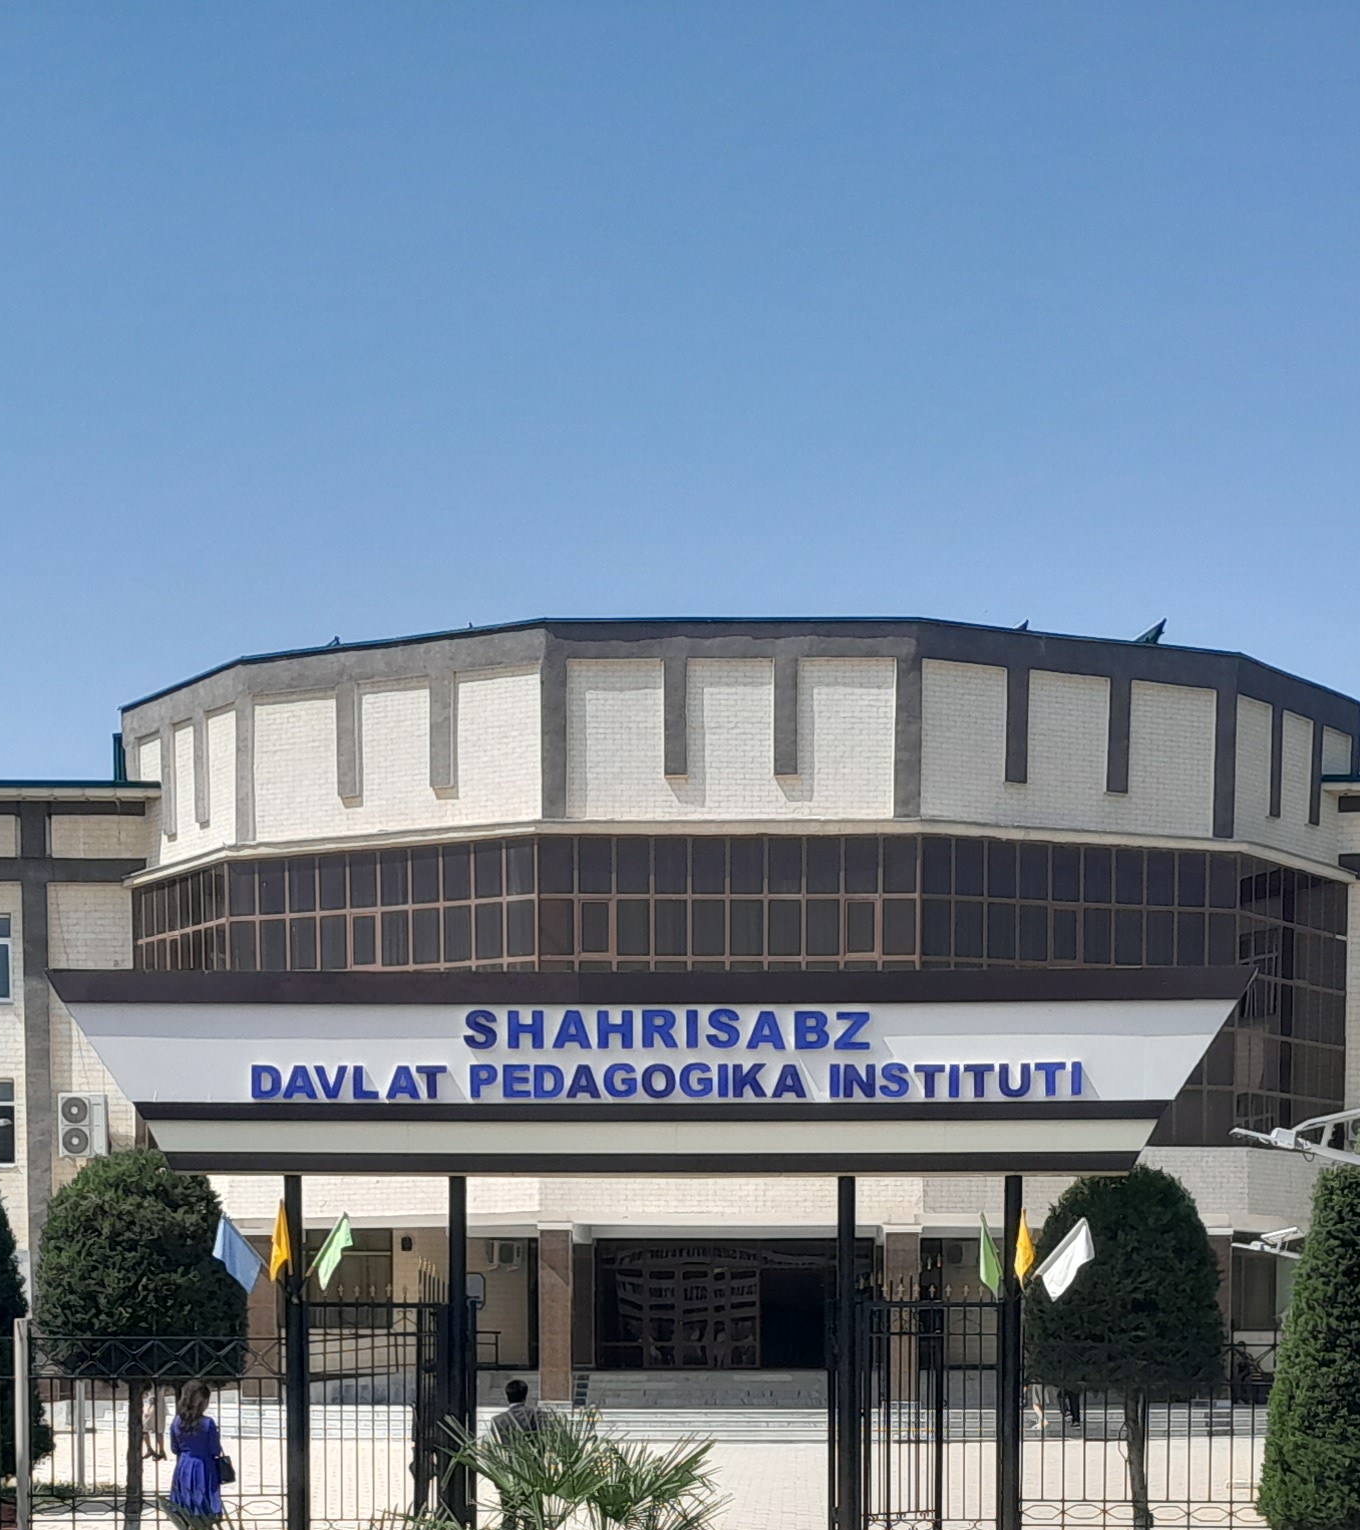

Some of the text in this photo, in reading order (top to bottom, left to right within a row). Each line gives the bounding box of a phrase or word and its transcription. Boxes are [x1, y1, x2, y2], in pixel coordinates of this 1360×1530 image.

[464, 1006, 872, 1052] SHAHRISABZ
[251, 1061, 1085, 1101] DAVLAT PEDAGOGIKA INSTITUTI
